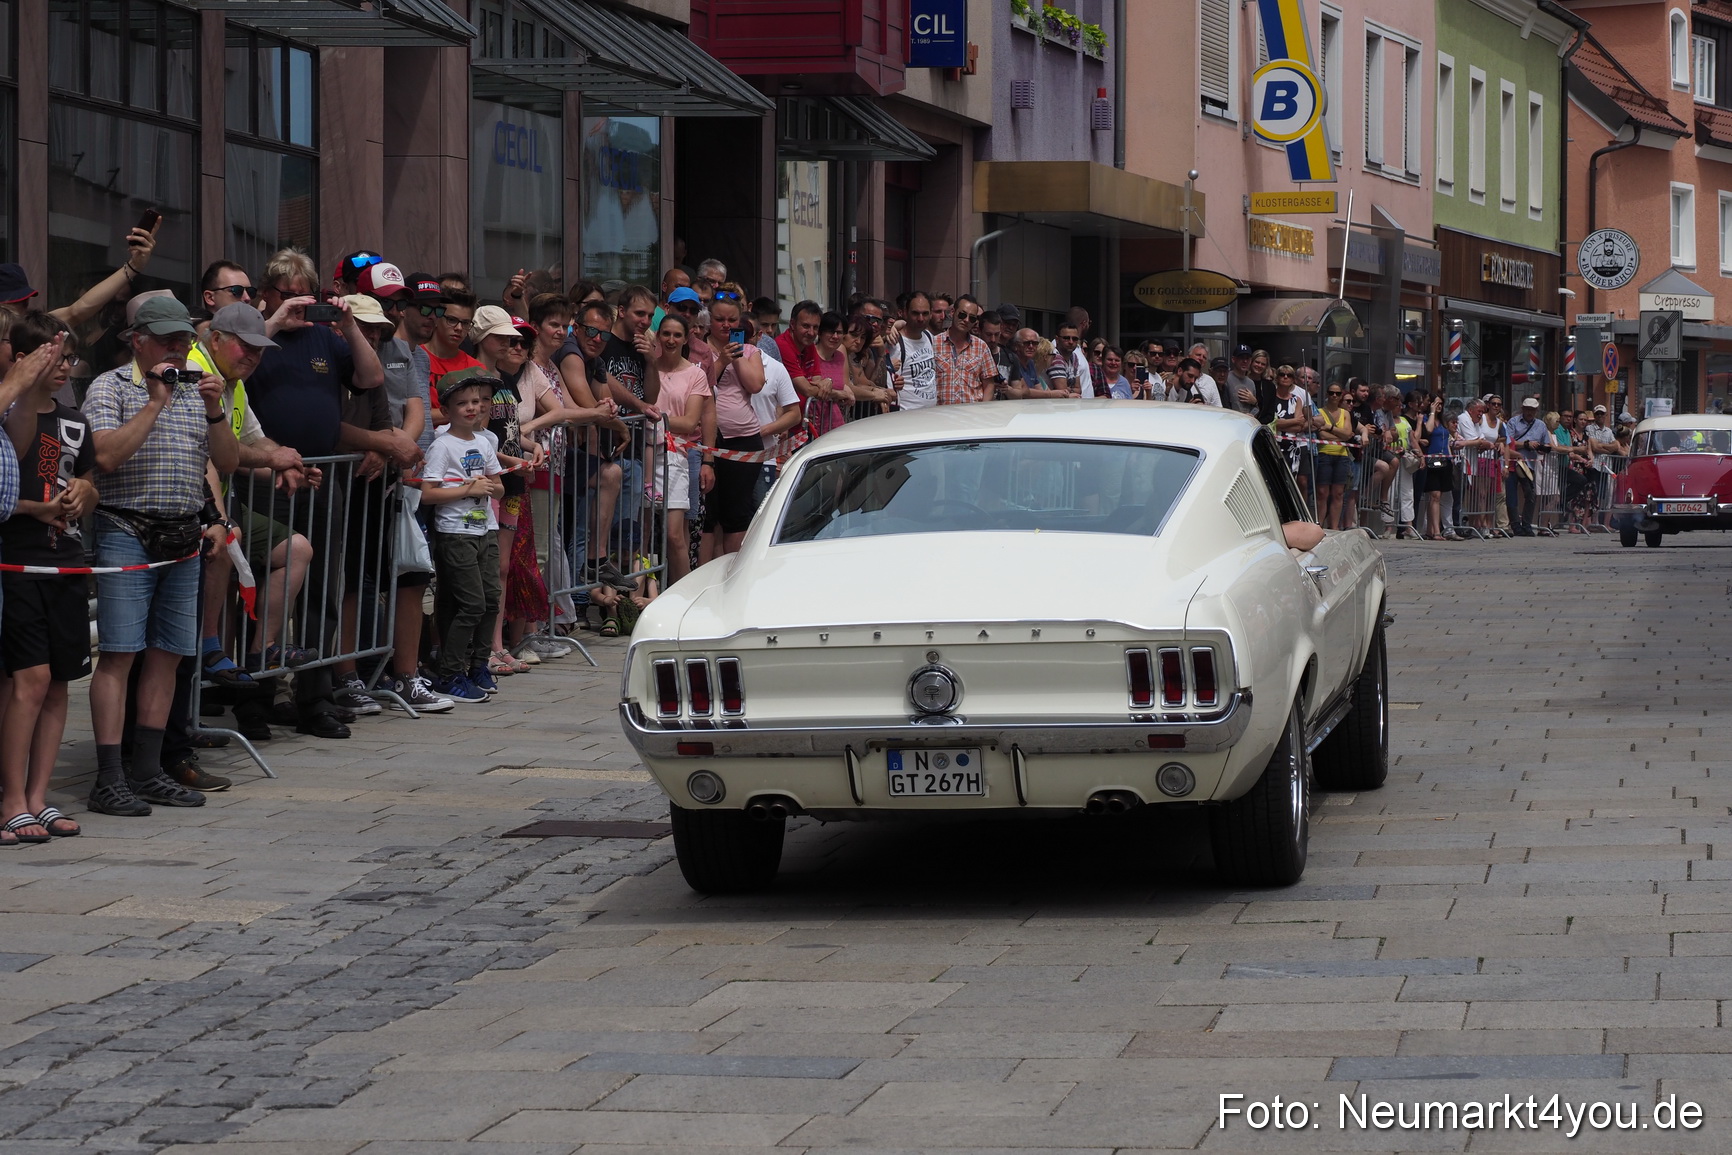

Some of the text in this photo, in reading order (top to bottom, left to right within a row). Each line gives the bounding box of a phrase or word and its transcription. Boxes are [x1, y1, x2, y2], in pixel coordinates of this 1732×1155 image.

[913, 13, 955, 35] CIL
[1260, 80, 1299, 121] B
[494, 120, 543, 173] CECIL
[599, 146, 643, 193] CECIL
[793, 189, 823, 230] CECIL
[1255, 197, 1330, 208] KLOSTERGASSE 4
[1138, 287, 1235, 296] DIE GOLDSCHMIEDE
[1654, 294, 1701, 310] Creppresso
[1577, 315, 1607, 323] Klostergasse
[1665, 502, 1672, 512] R
[766, 628, 1097, 645] MUSTANG
[892, 762, 899, 770] D
[915, 751, 929, 771] N
[891, 772, 980, 794] GT 267H
